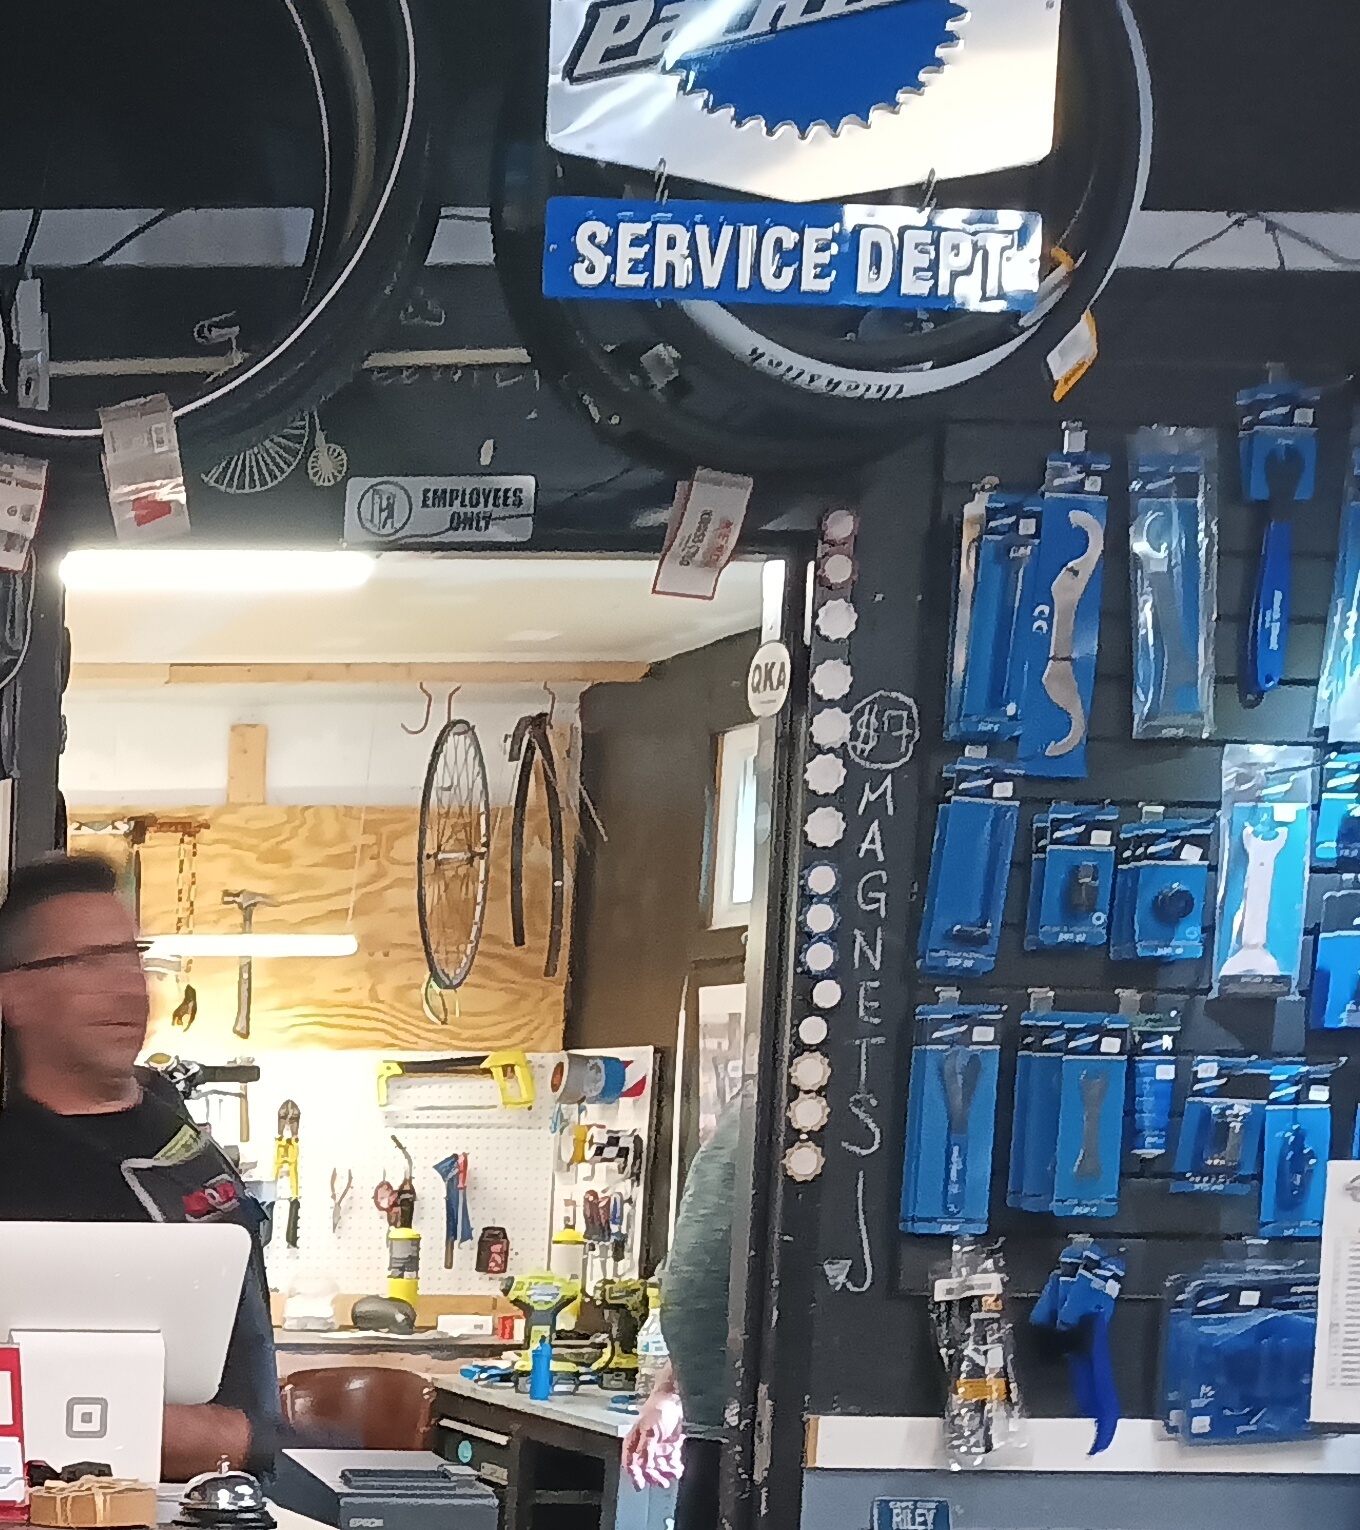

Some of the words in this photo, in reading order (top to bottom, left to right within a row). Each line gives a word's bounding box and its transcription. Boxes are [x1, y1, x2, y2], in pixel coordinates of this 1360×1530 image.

[572, 220, 838, 293] SERVICE
[420, 487, 524, 509] EMPLOYEES
[449, 511, 493, 532] ONLY
[841, 774, 895, 1156] MAGNETS
